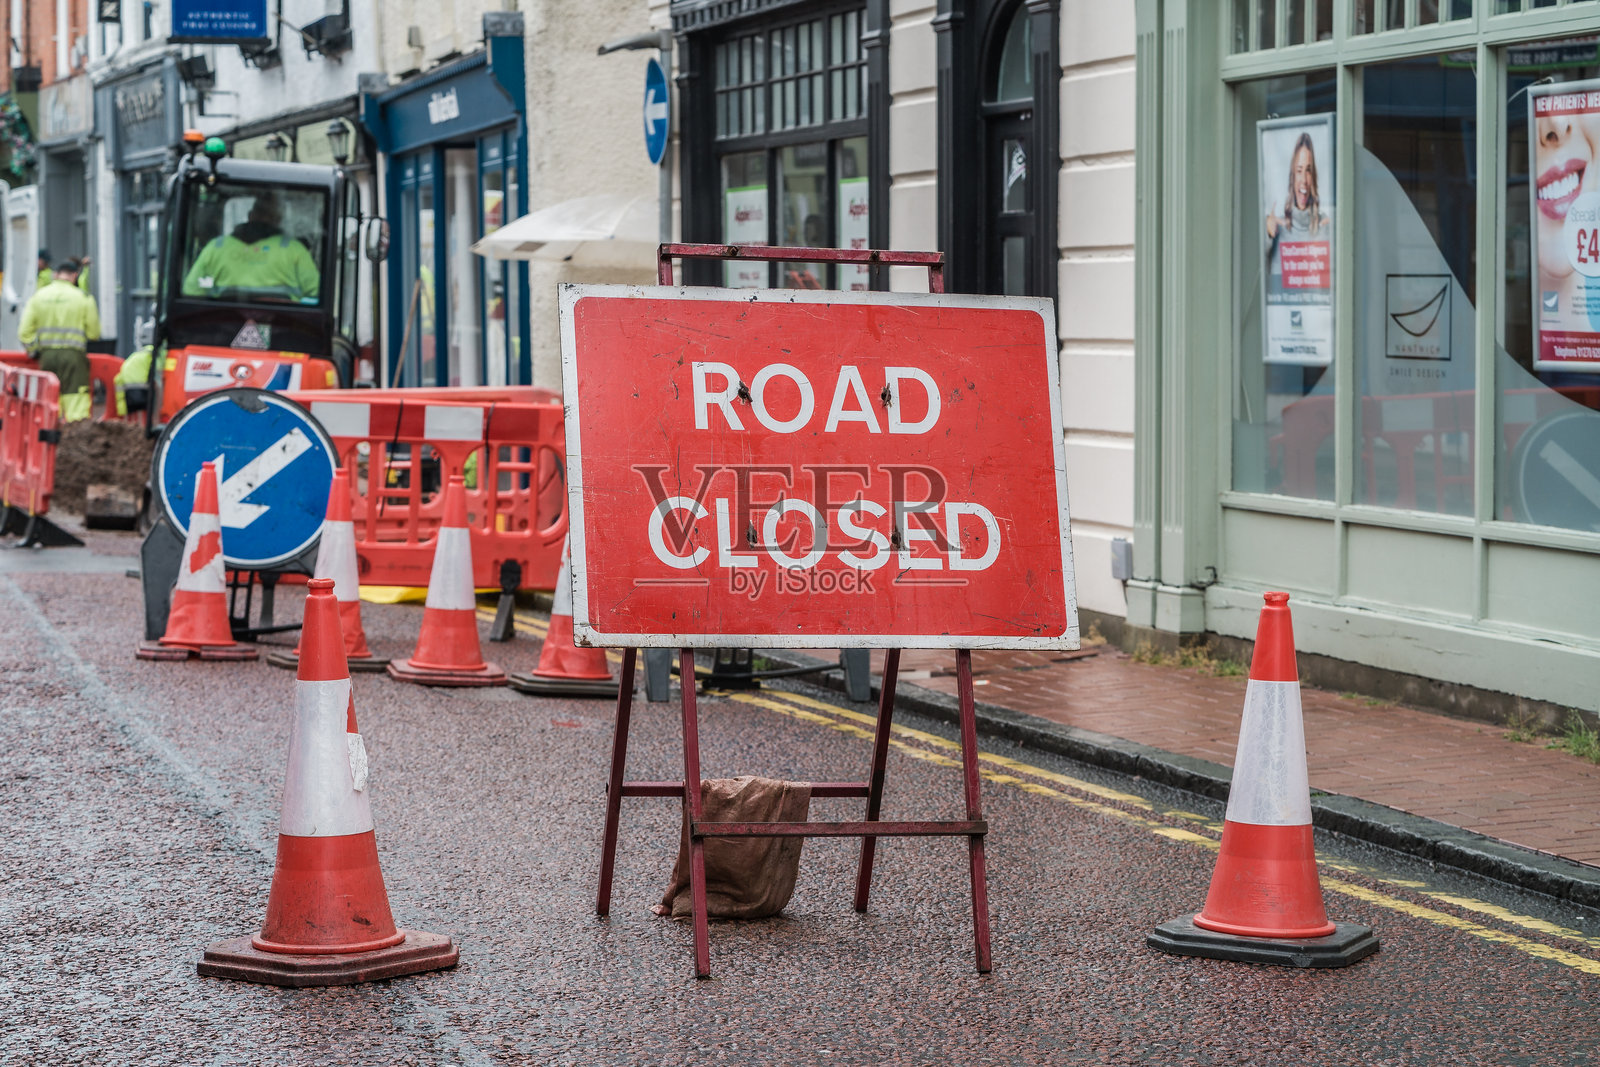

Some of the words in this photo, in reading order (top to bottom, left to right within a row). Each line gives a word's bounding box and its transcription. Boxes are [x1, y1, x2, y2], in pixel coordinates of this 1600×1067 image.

[1536, 95, 1553, 112] NEW
[1553, 92, 1586, 111] PATIENTS
[691, 361, 942, 434] ROAD
[648, 496, 1001, 571] CLOSED
